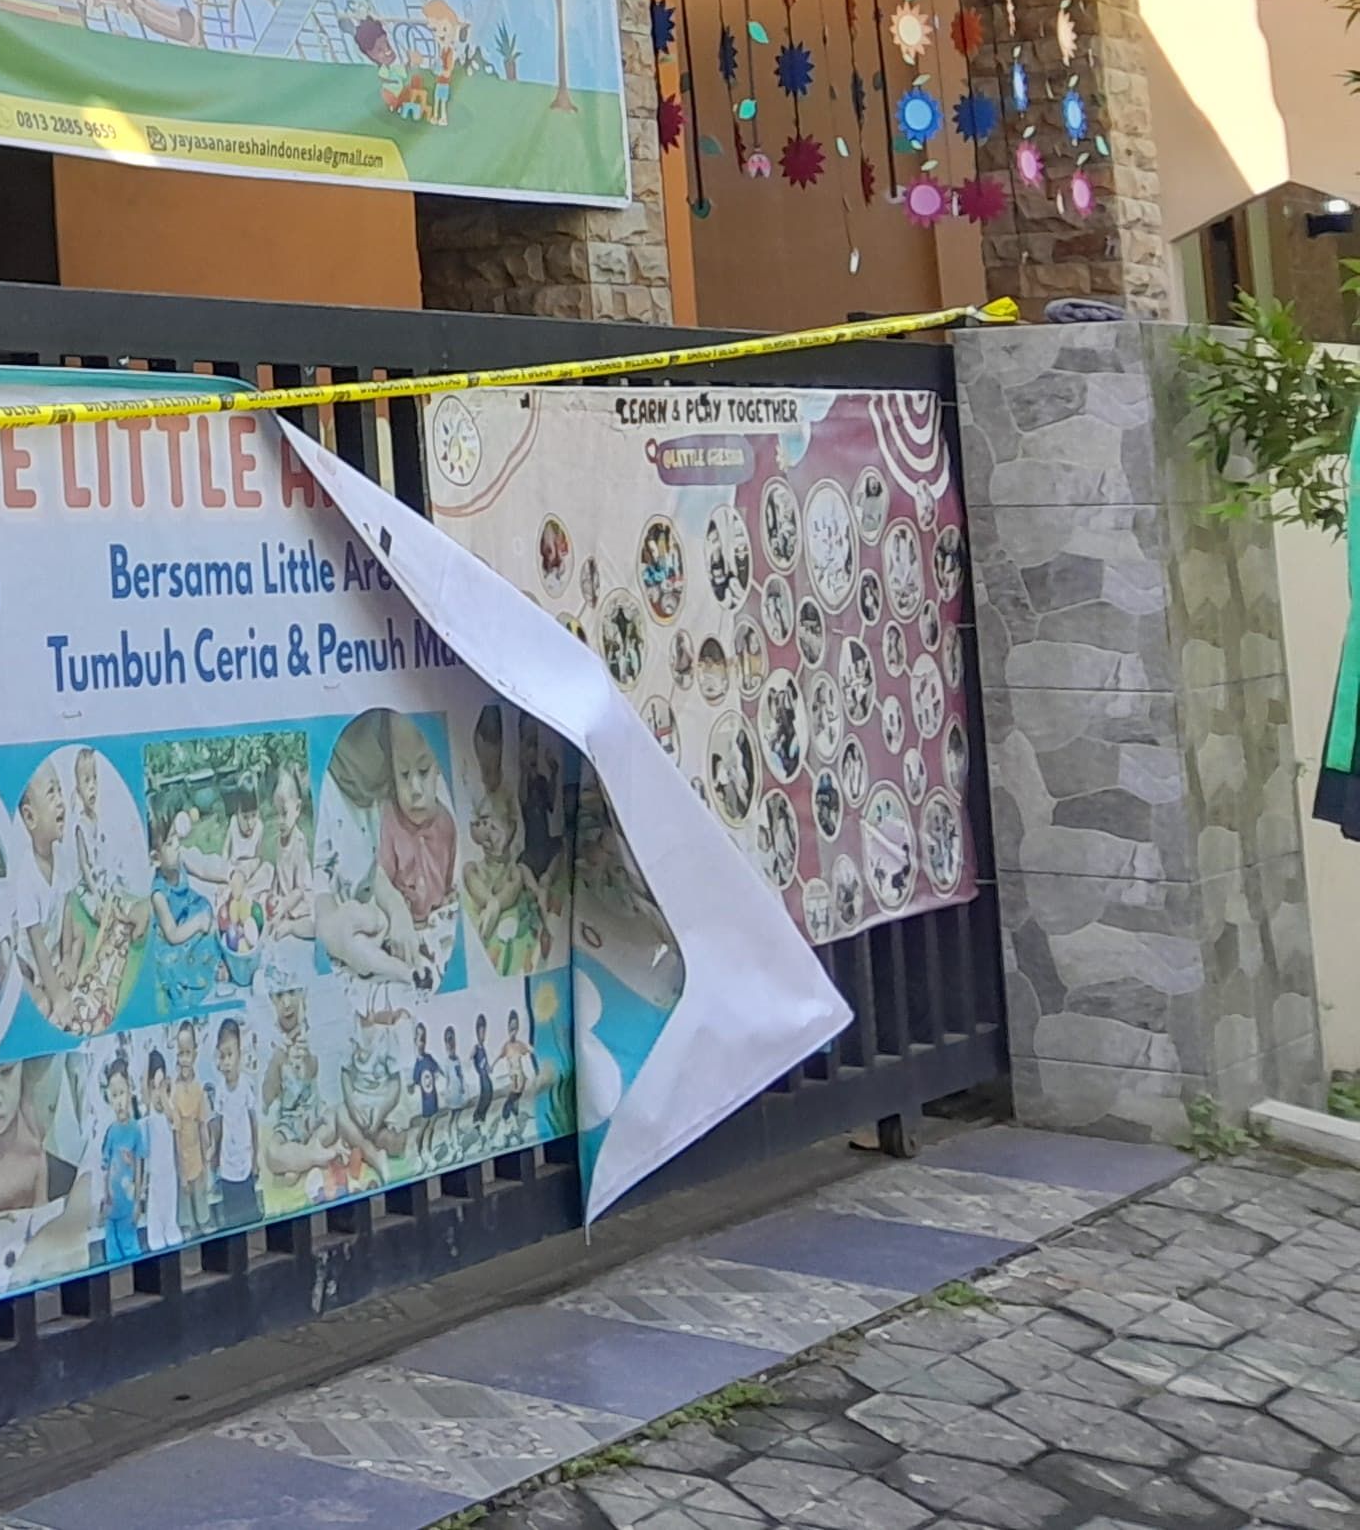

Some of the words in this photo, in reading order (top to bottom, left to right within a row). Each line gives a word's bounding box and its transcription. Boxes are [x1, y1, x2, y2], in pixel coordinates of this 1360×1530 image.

[16, 110, 49, 131] 0813
[52, 115, 83, 136] 2885
[84, 121, 117, 139] 9659
[168, 132, 383, 169] yayasanareshaindonesia@gmail.com
[617, 397, 668, 425] LEARN
[685, 397, 721, 423] PLAY
[727, 397, 798, 422] TOGETHER
[60, 412, 263, 508] LITTLE
[108, 542, 254, 600] Bersama
[260, 539, 335, 596] Little
[343, 540, 401, 592] Are
[46, 627, 186, 693] Tumbuh
[193, 626, 278, 684] Ceria
[287, 622, 312, 677] &
[318, 617, 406, 676] Penuh
